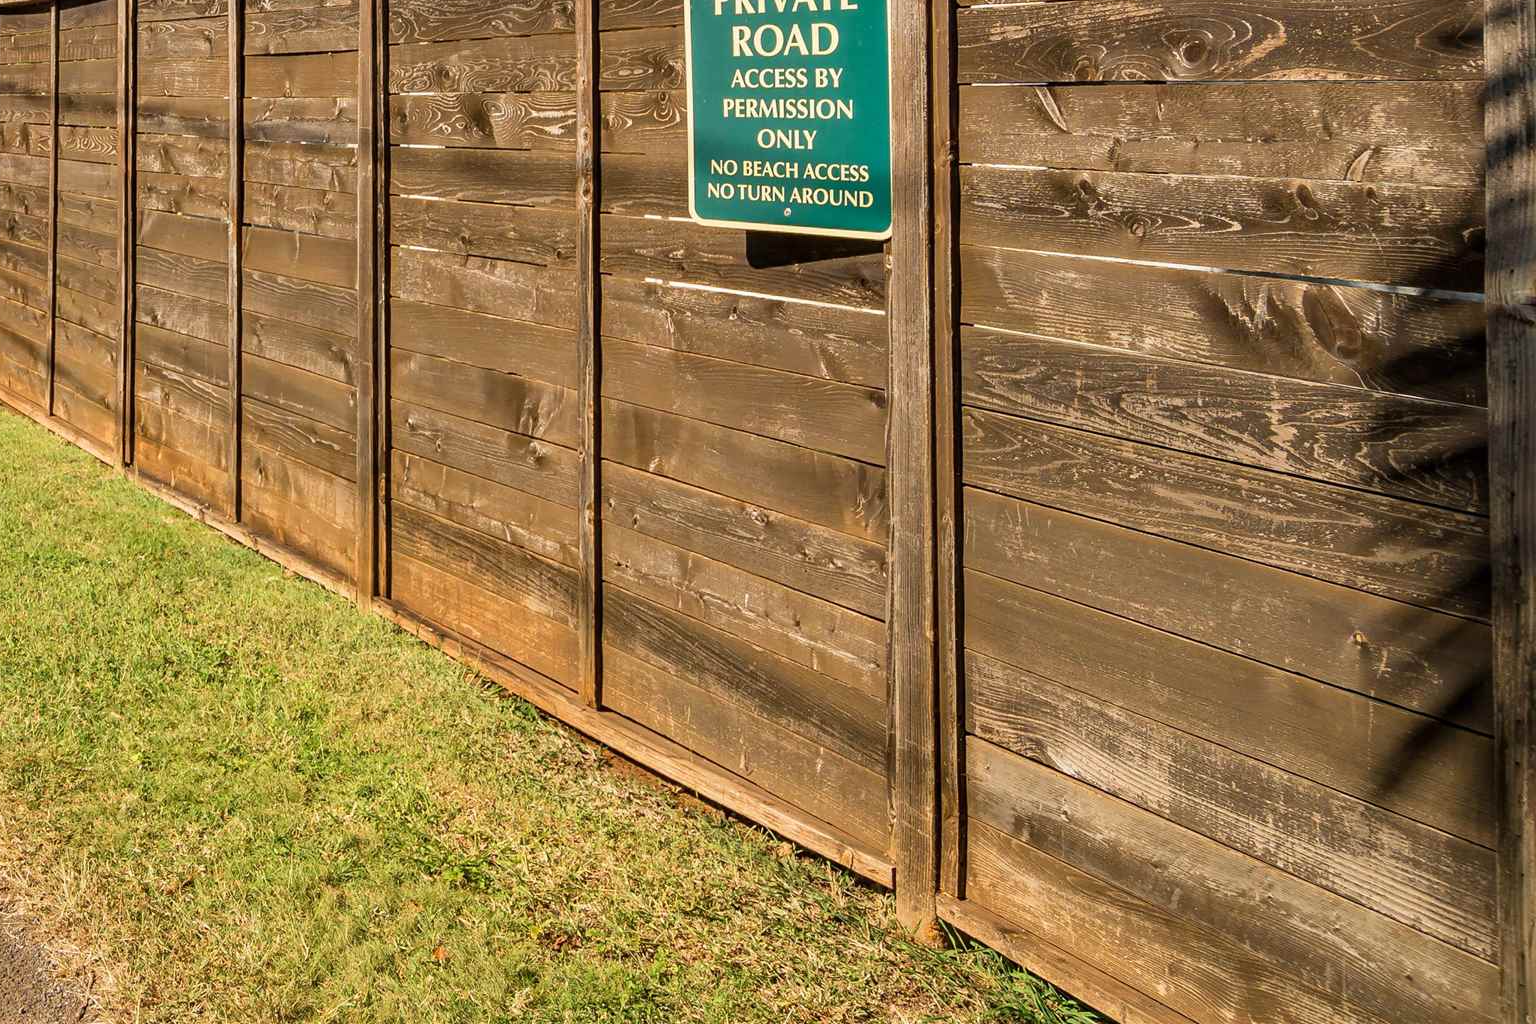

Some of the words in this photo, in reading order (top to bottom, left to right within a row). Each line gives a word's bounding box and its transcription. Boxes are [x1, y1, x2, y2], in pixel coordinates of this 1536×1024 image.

[732, 23, 839, 57] ROAD
[731, 69, 807, 88] ACCESS
[815, 68, 843, 88] BY
[723, 99, 854, 120] PERMISSION
[757, 129, 817, 150] ONLY
[711, 160, 738, 176] NO
[743, 160, 798, 179] BEACH
[803, 163, 869, 182] ACCESS
[708, 183, 735, 200] NO
[738, 185, 785, 202] TURN
[789, 187, 874, 208] AROUND
